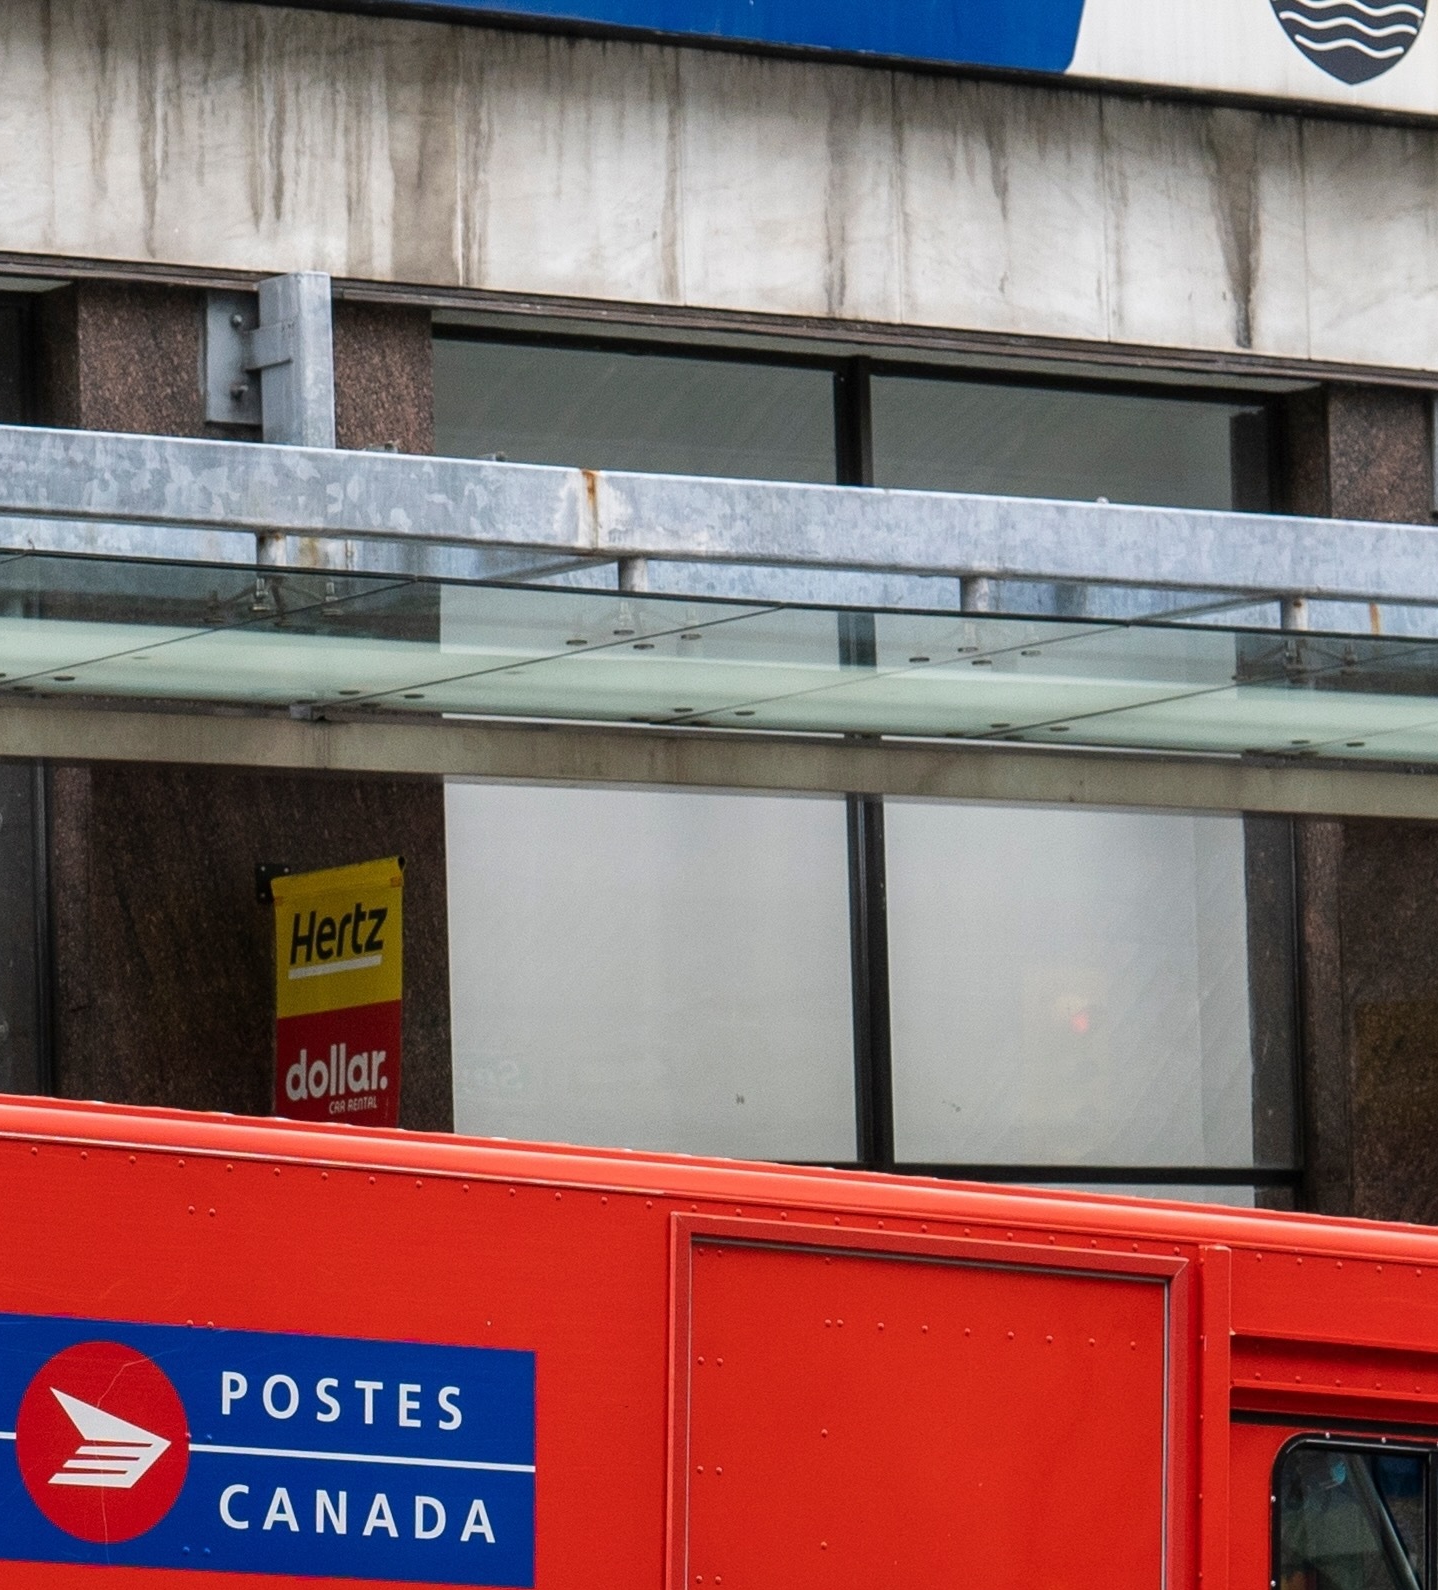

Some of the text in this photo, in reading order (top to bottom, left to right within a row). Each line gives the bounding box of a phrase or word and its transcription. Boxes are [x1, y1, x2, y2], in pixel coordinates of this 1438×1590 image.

[290, 902, 388, 966] Hertz
[285, 1043, 388, 1101] dollar.
[329, 1095, 378, 1115] CAR RENTAL
[221, 1370, 464, 1431] POSTES
[219, 1483, 497, 1544] CANADA
